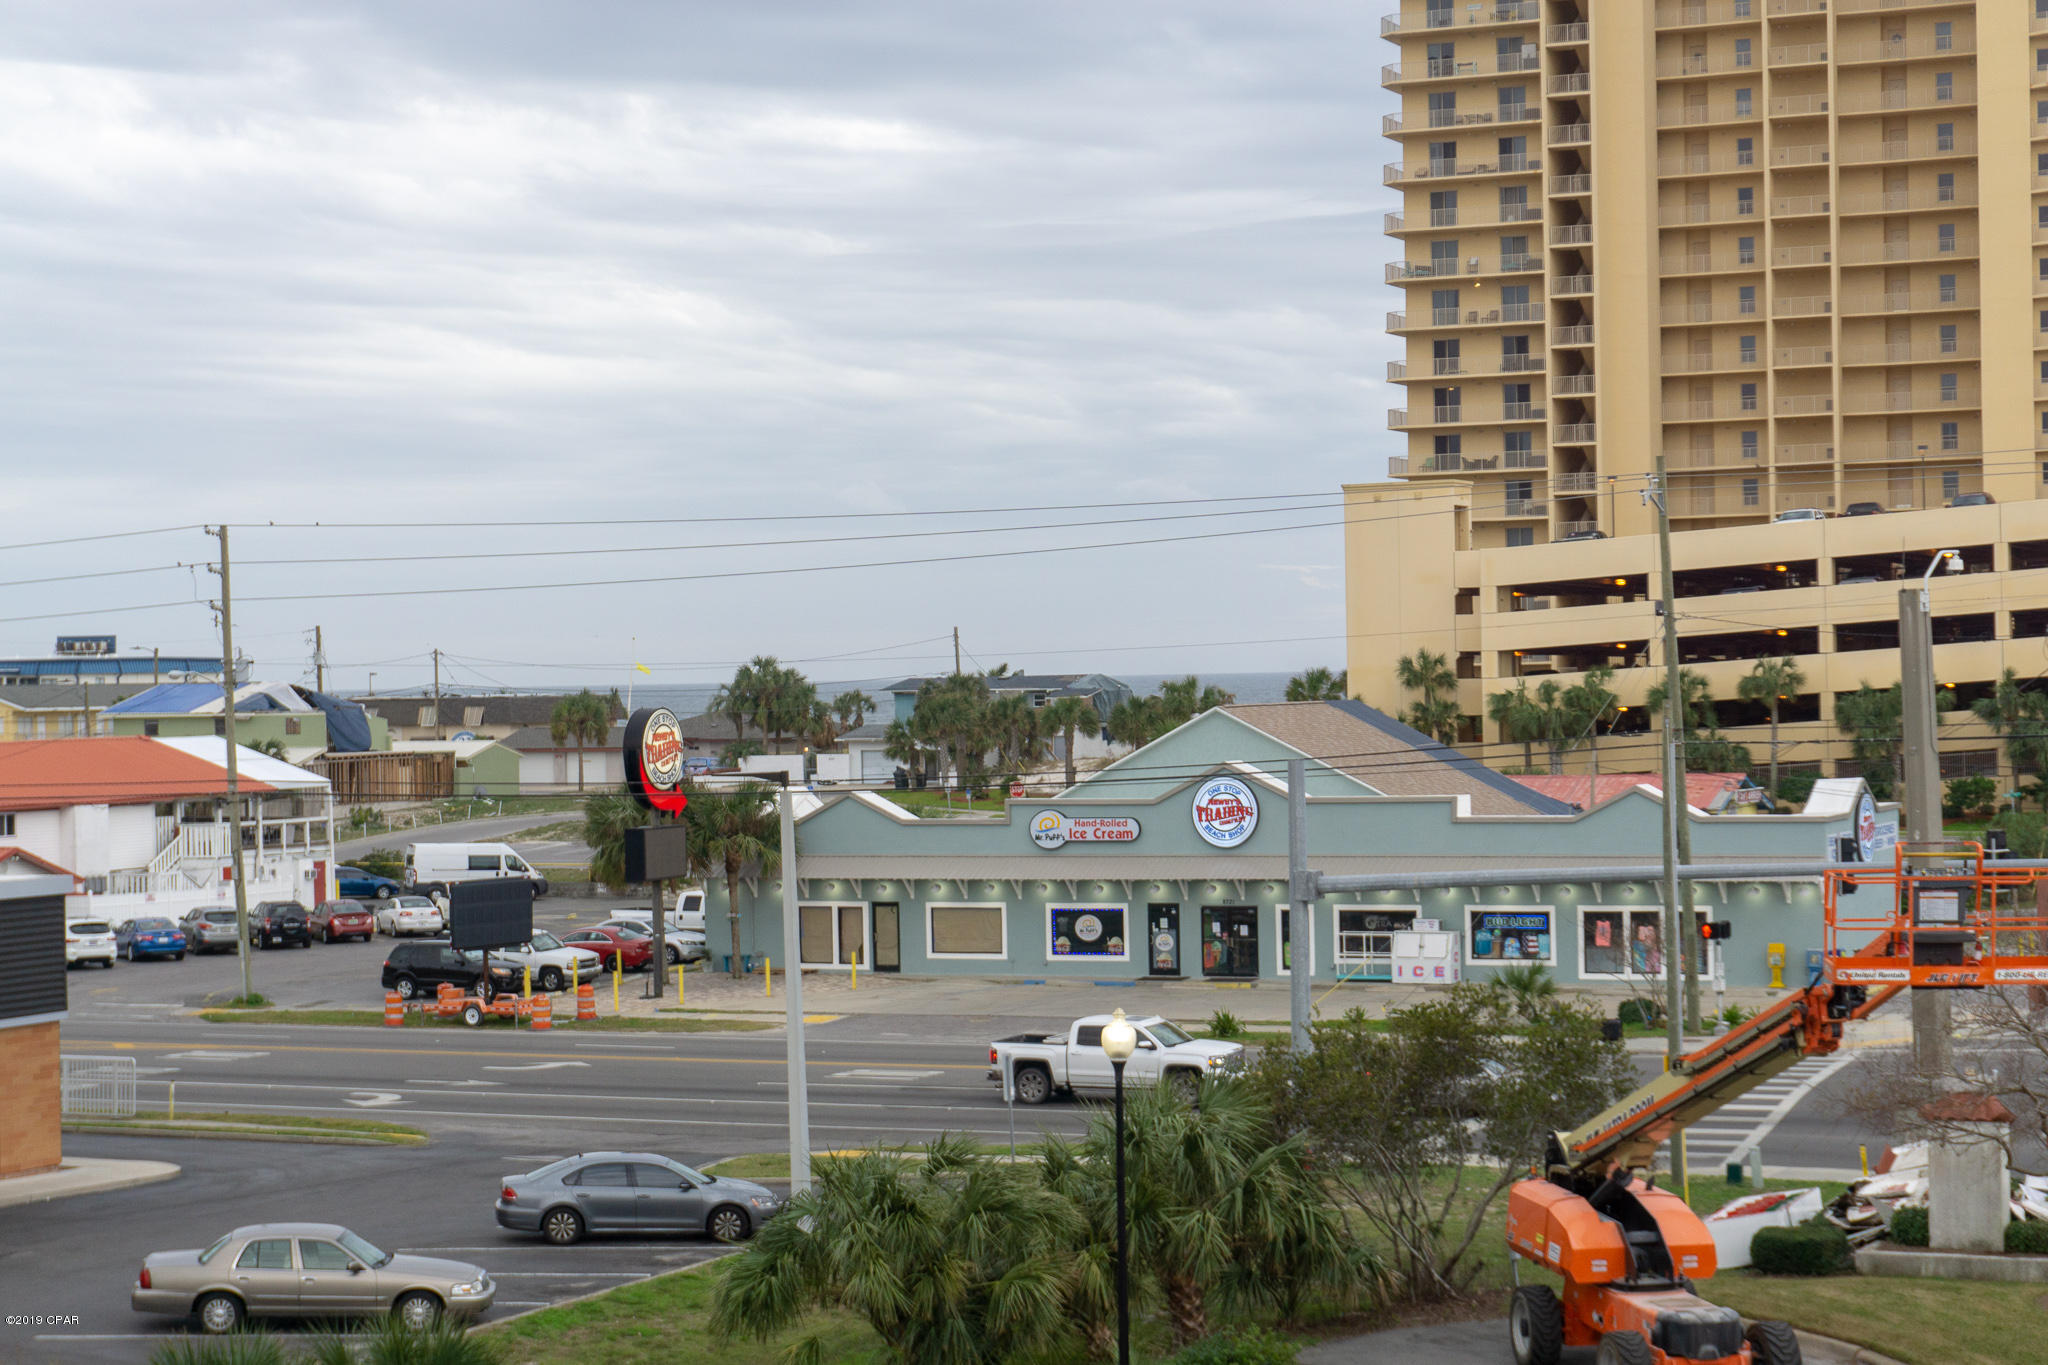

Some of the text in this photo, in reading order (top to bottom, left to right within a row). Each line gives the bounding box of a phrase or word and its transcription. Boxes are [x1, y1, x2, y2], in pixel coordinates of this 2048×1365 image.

[650, 714, 676, 732] ONE STOP
[646, 740, 683, 764] TRADING
[652, 767, 677, 781] BEACH SHOP
[1011, 784, 1024, 793] STOP
[1207, 785, 1241, 796] ONE STOP
[1196, 805, 1253, 822] TRADING
[1074, 819, 1128, 828] Hand-Rolled
[1069, 828, 1133, 840] Ice Cream
[1204, 824, 1245, 838] BEACH SHOP
[1397, 965, 1446, 977] ICE
